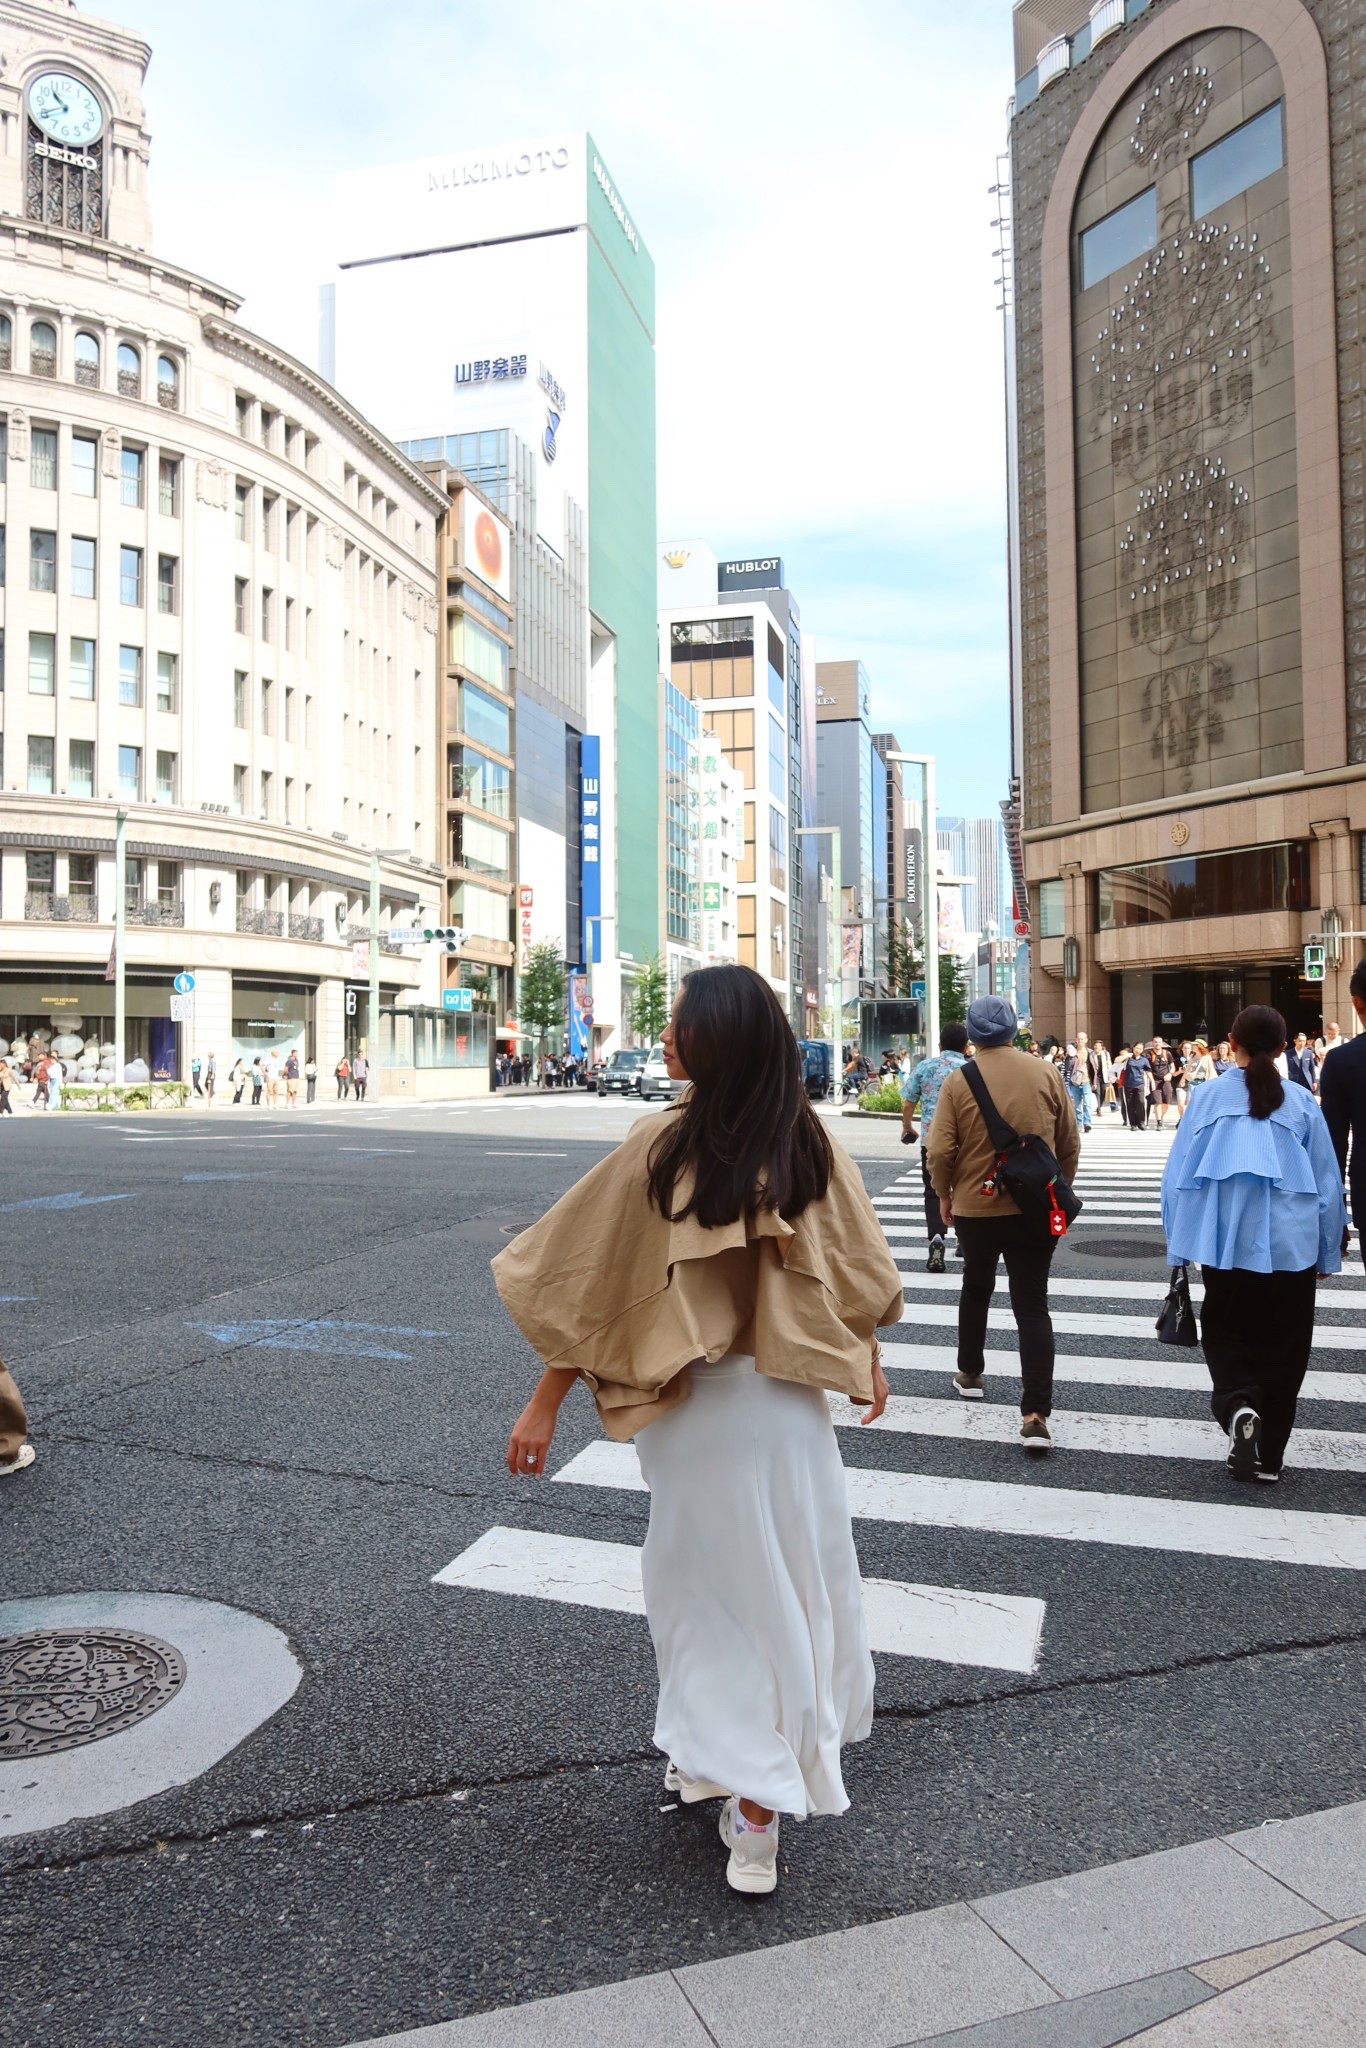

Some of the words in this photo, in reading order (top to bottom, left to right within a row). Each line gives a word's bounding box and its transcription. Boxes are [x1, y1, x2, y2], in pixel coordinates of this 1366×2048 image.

[40, 85, 50, 97] 10
[61, 81, 72, 92] 12
[36, 95, 44, 106] 9
[84, 98, 91, 110] 2
[87, 111, 95, 122] 3
[50, 119, 58, 129] 7
[82, 121, 91, 131] 4
[61, 125, 69, 137] 6
[74, 125, 81, 137] 5
[35, 142, 97, 170] SEIKO
[428, 148, 569, 191] MIKIMOTO
[455, 354, 527, 384] 山野楽器
[726, 559, 779, 574] HUBLOT
[815, 697, 837, 706] LEX
[583, 778, 599, 862] 山野楽器
[906, 844, 915, 903] BOUCHERON
